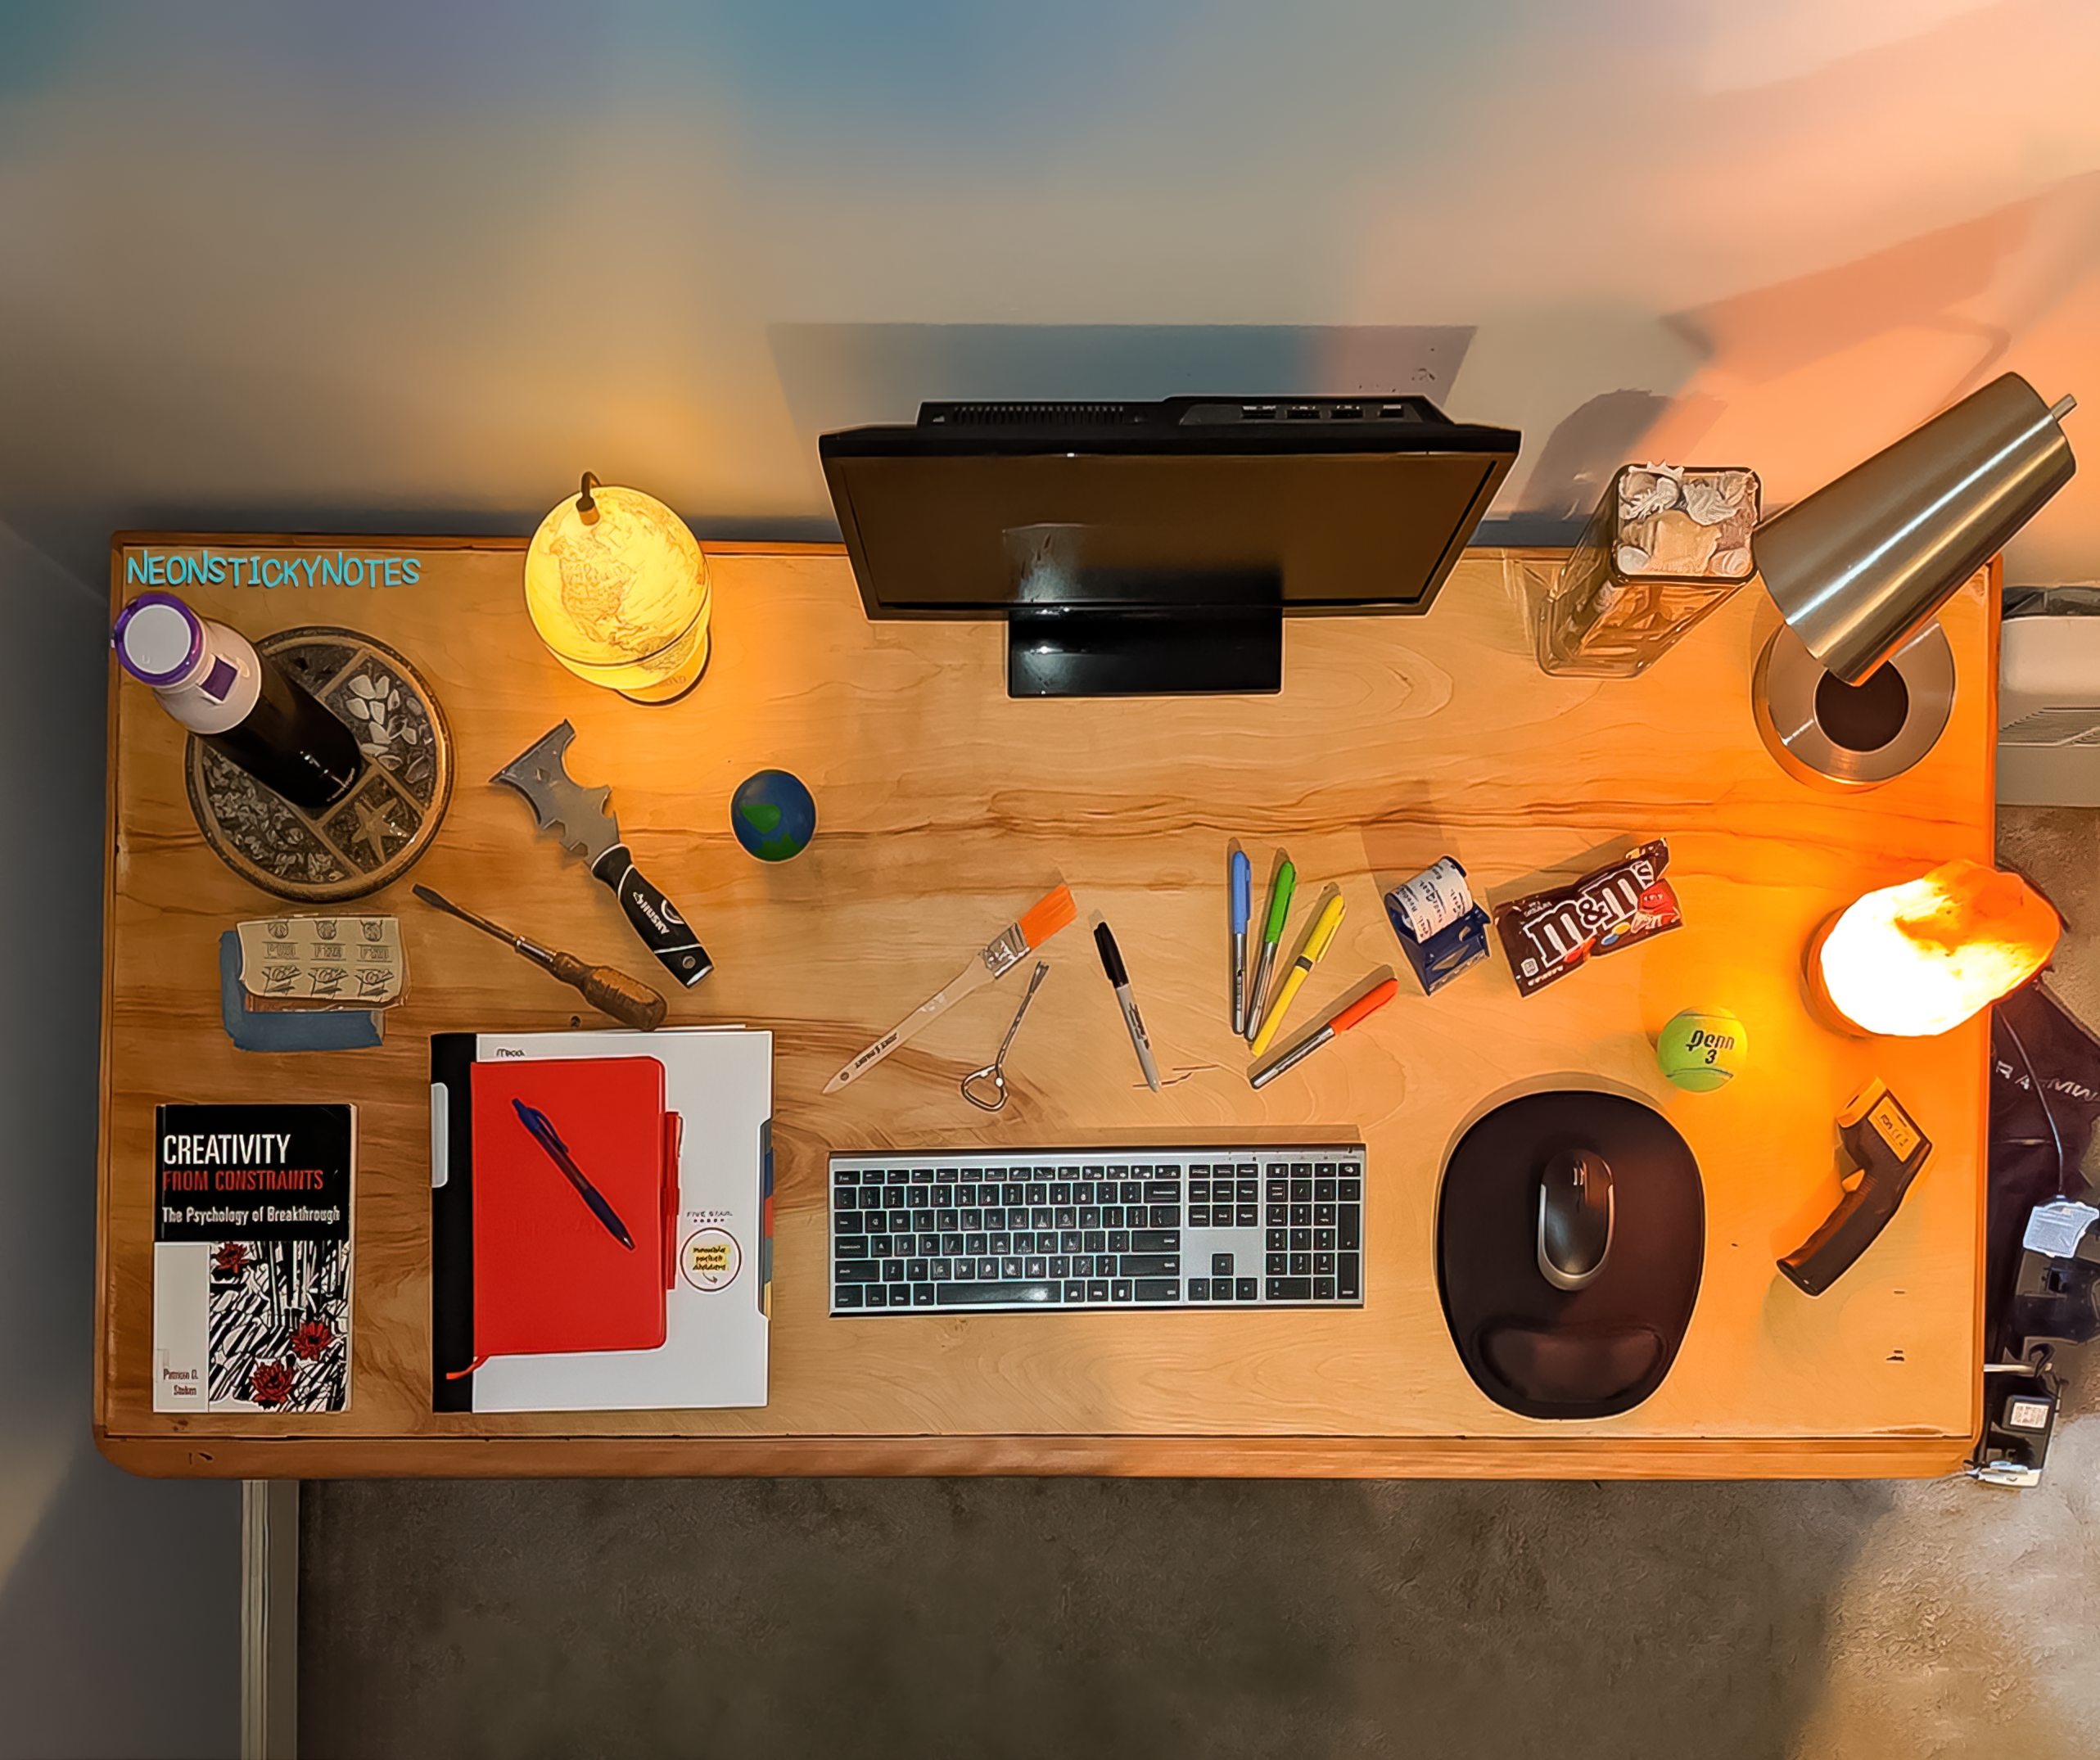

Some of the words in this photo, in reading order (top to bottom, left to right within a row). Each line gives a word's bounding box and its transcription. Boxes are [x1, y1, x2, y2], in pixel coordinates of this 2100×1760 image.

[1686, 1030, 1735, 1052] Penn
[1705, 1049, 1718, 1064] 3
[163, 1133, 291, 1165] CREATIVITY
[163, 1170, 209, 1191] FROM
[215, 1169, 324, 1191] CONSTRAINTS
[162, 1207, 183, 1223] The
[186, 1206, 249, 1225] Psychology
[251, 1205, 264, 1222] of
[267, 1205, 341, 1225] Breakthrough
